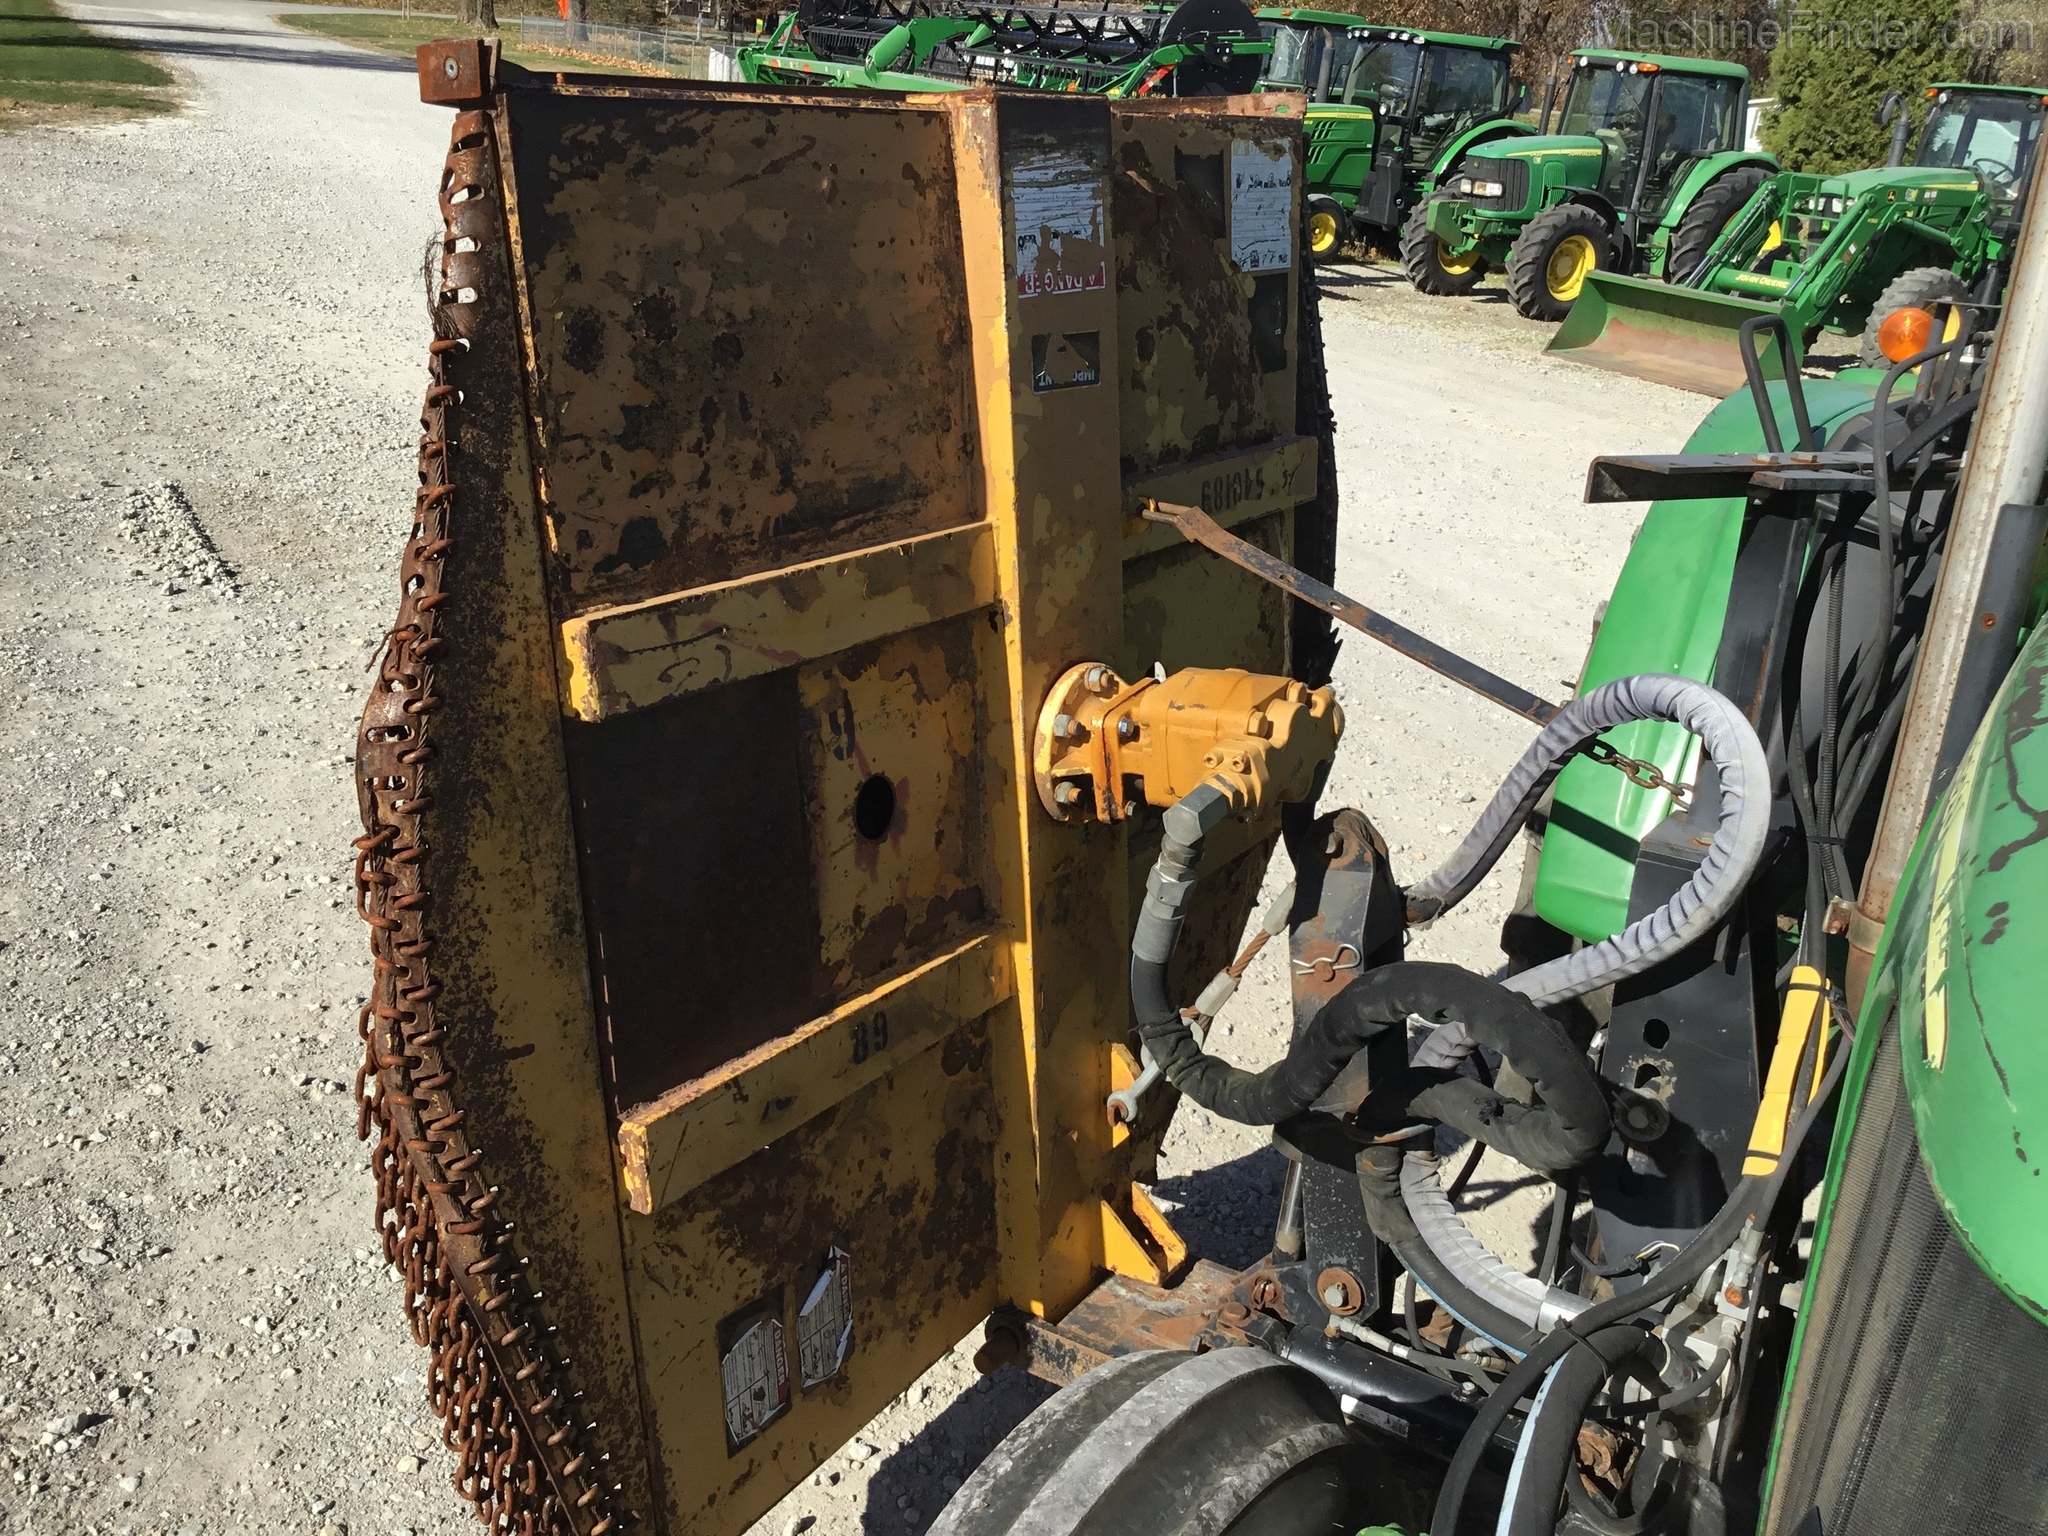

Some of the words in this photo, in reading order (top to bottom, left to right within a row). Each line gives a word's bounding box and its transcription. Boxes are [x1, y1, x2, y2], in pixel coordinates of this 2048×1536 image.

[1735, 273, 1760, 284] JOHN
[1760, 276, 1790, 289] DEERE
[774, 1329, 786, 1386] DANGER
